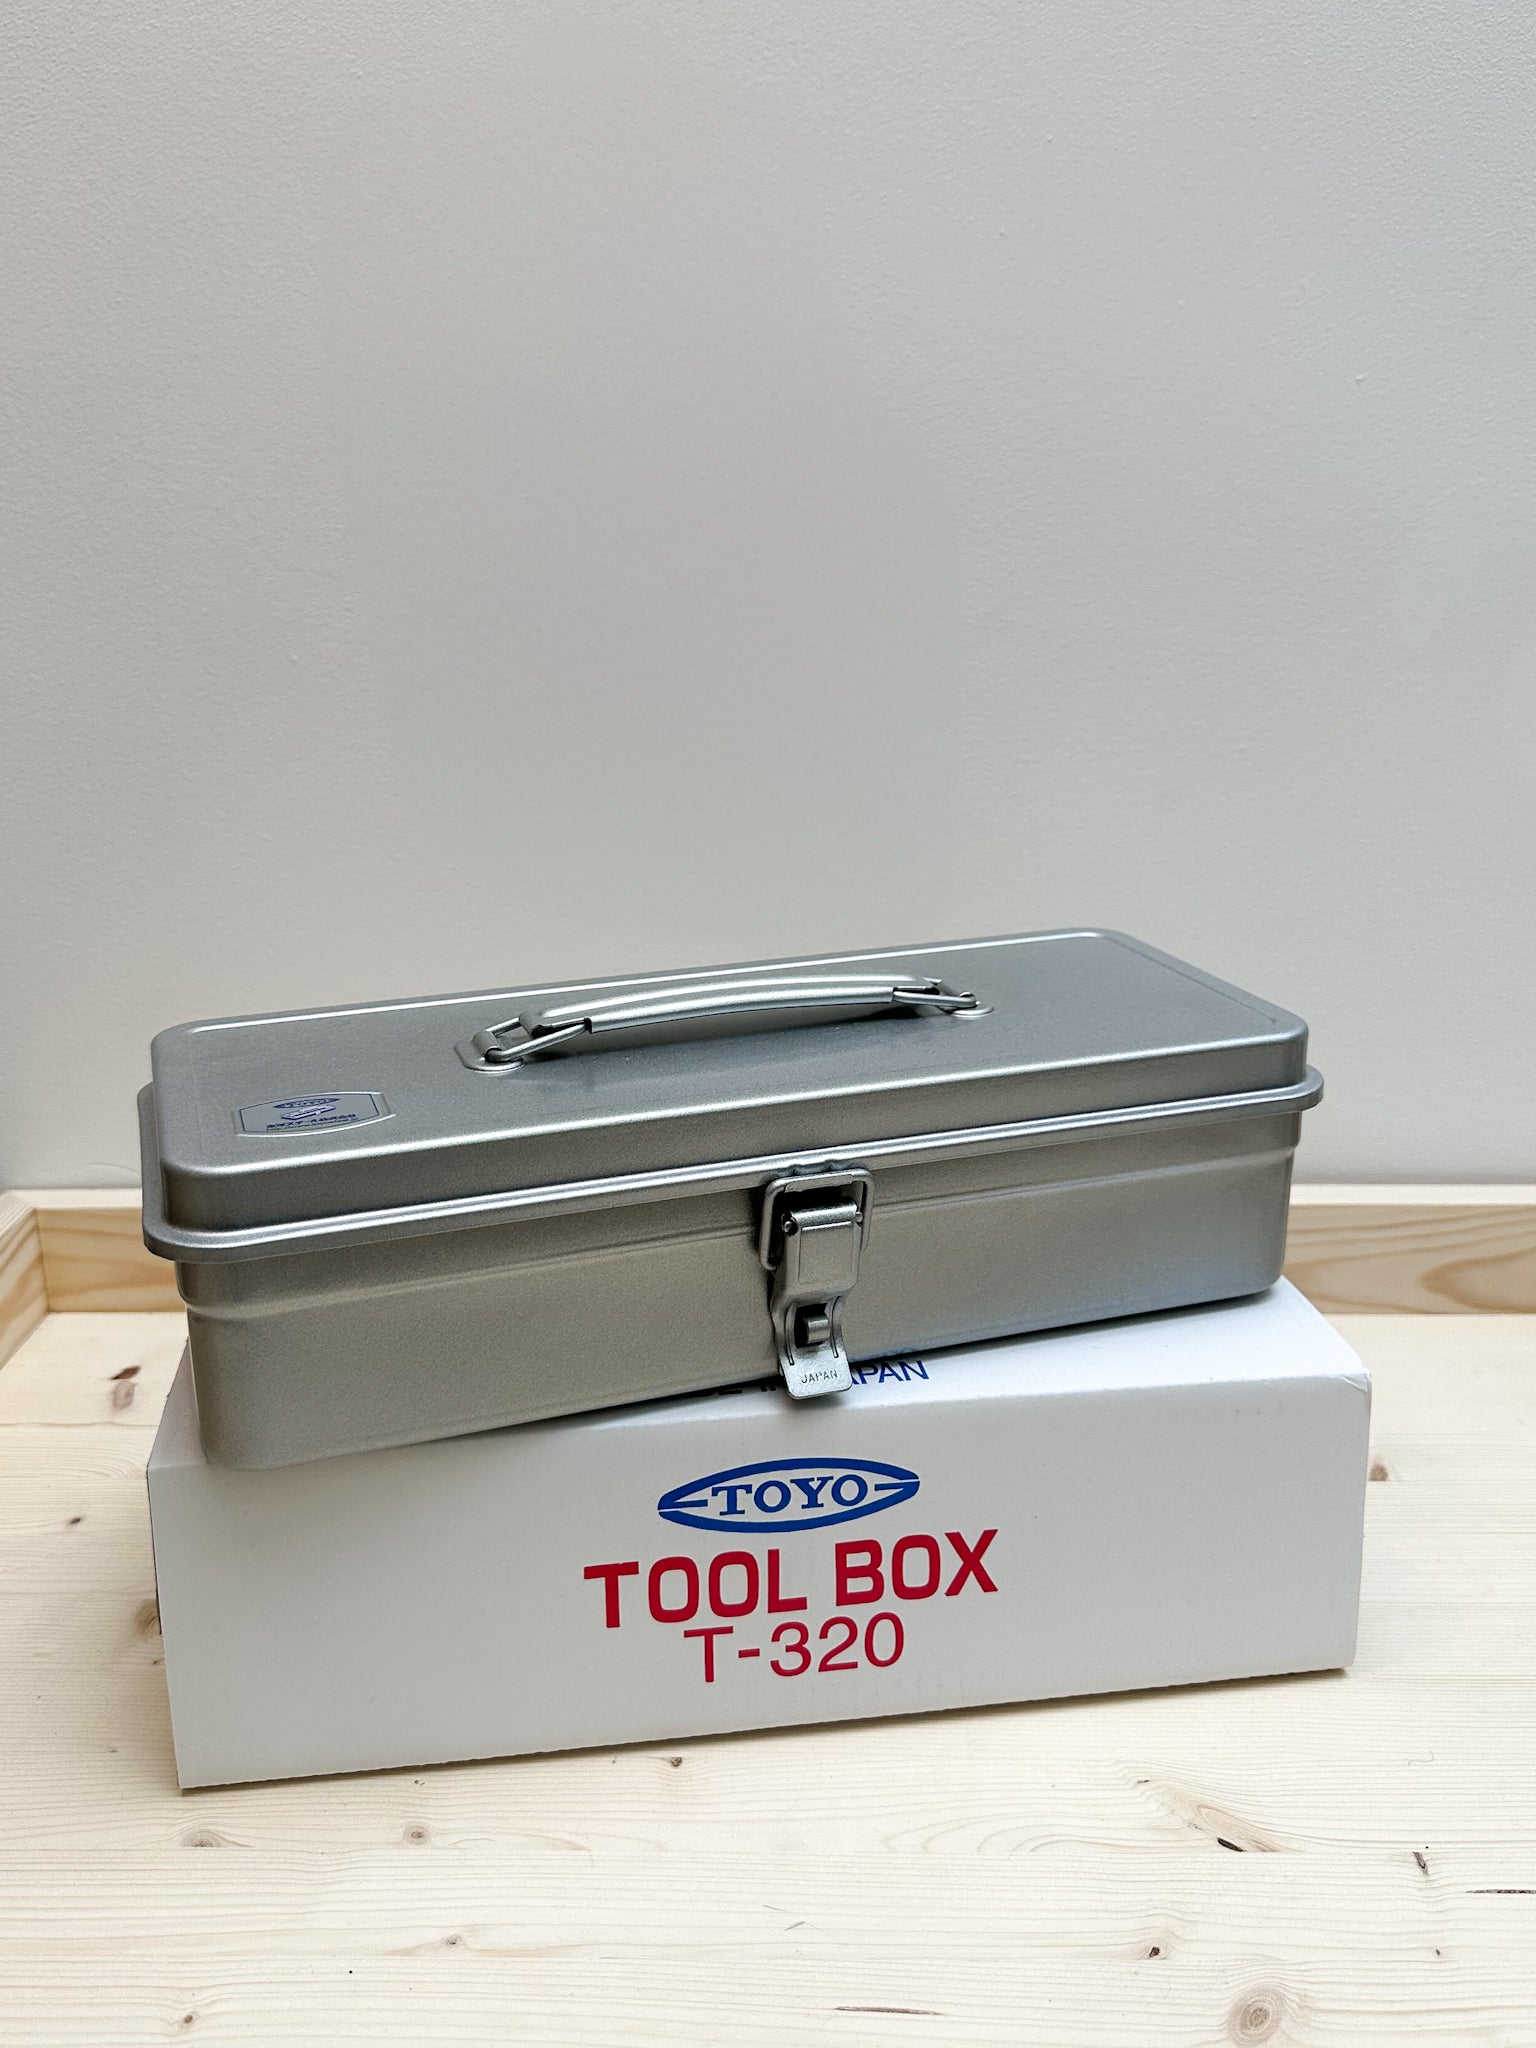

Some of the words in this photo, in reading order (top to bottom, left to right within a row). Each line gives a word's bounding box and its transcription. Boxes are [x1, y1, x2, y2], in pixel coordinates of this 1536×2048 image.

[801, 1369, 838, 1384] JAPAN
[851, 1360, 929, 1385] PAN
[711, 1474, 868, 1516] TOYO
[583, 1548, 808, 1628] TOOL
[836, 1528, 999, 1606] BOX
[684, 1611, 905, 1683] T-320
